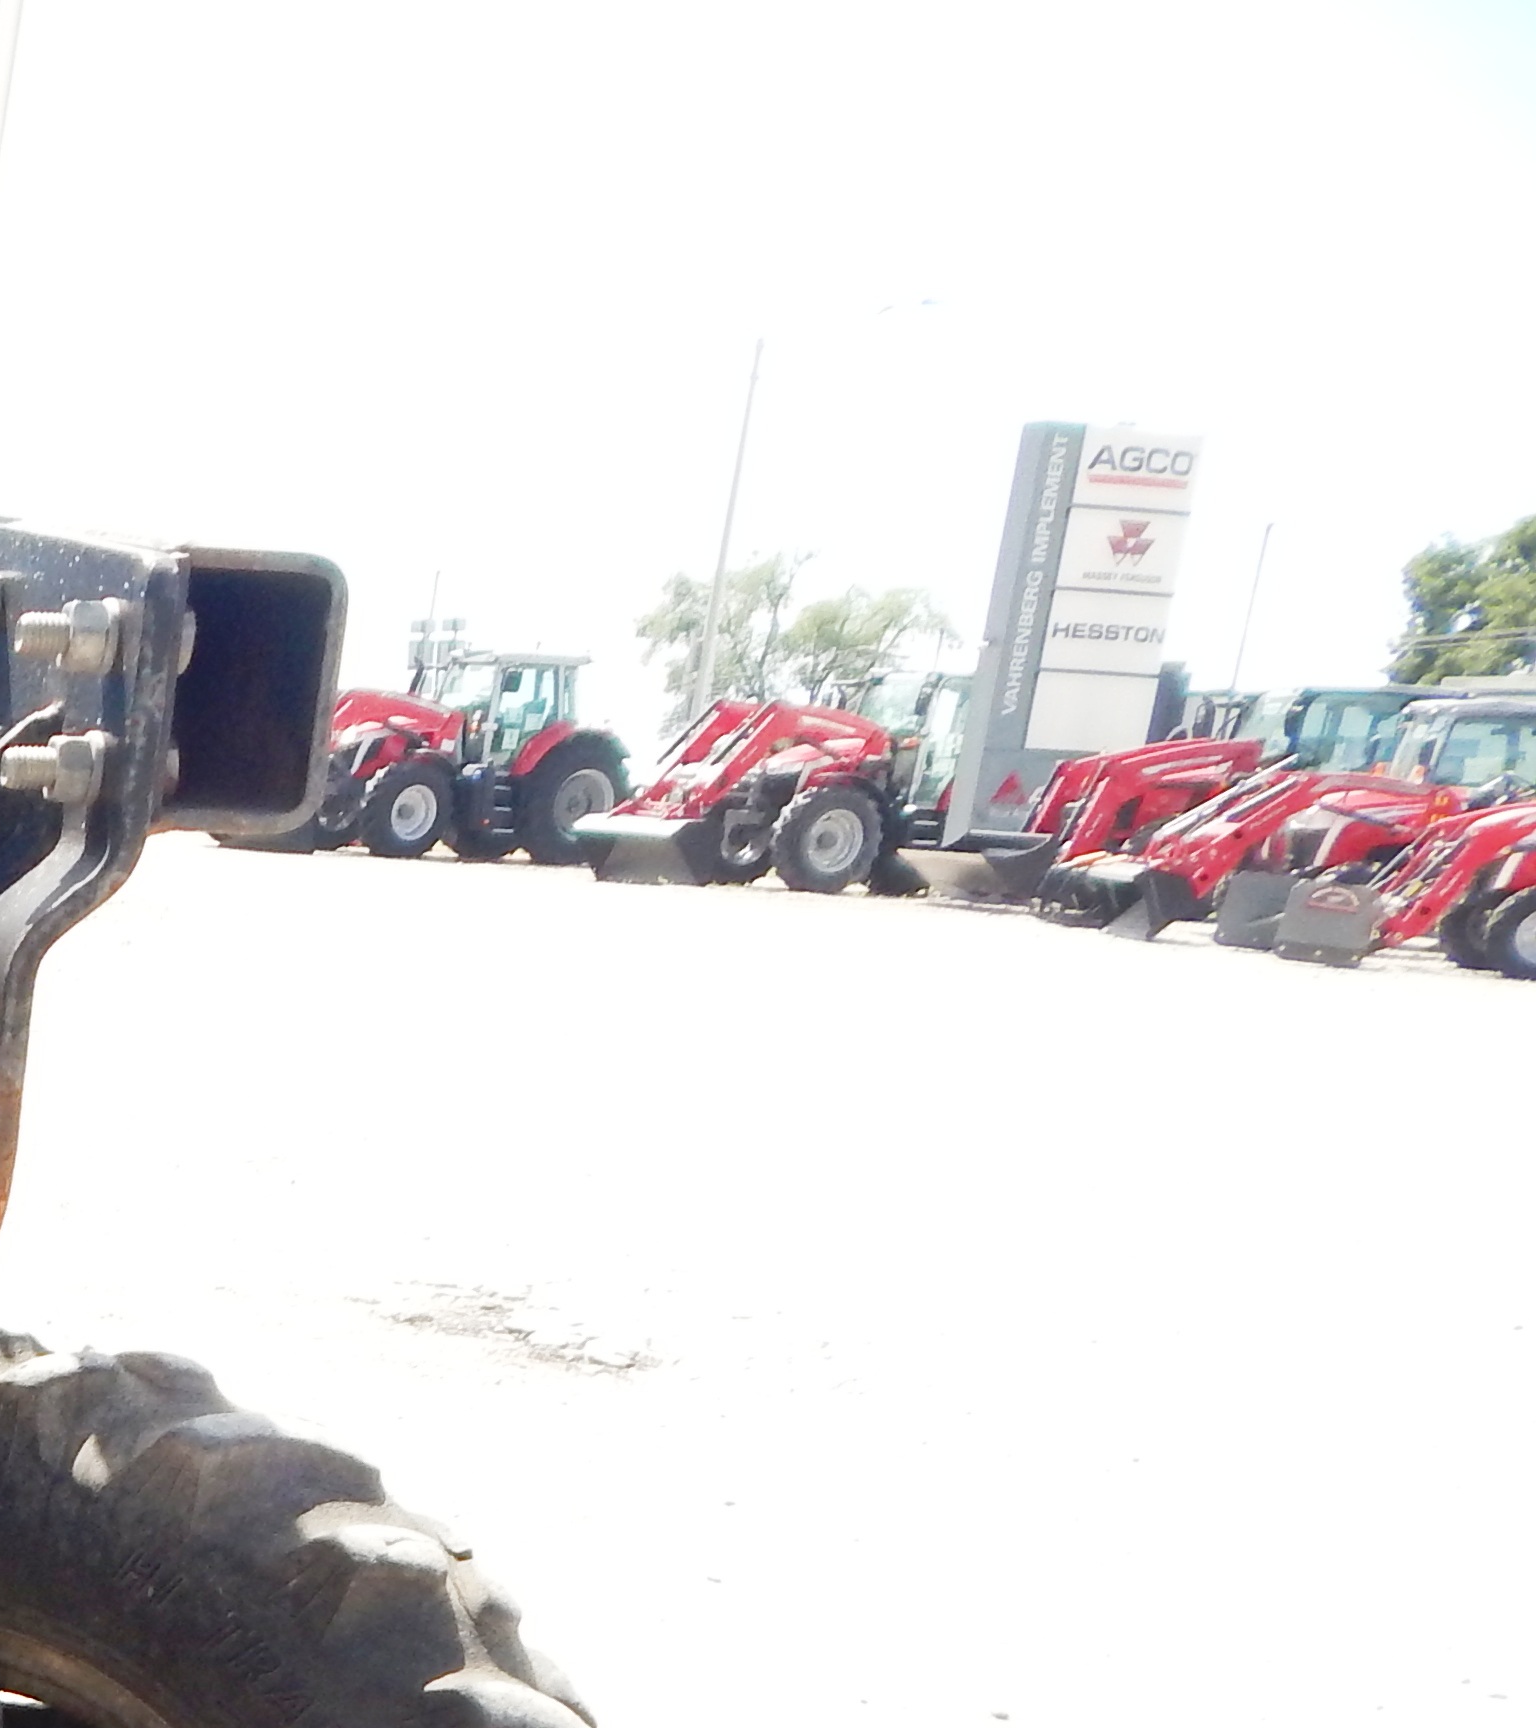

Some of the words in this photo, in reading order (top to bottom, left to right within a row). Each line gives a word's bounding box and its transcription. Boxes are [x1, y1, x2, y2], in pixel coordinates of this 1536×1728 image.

[1088, 444, 1194, 476] AGCO
[1001, 570, 1044, 716] VAHRENBERG
[1031, 431, 1069, 564] IMPLEMENT
[1052, 622, 1166, 644] HESSTON
